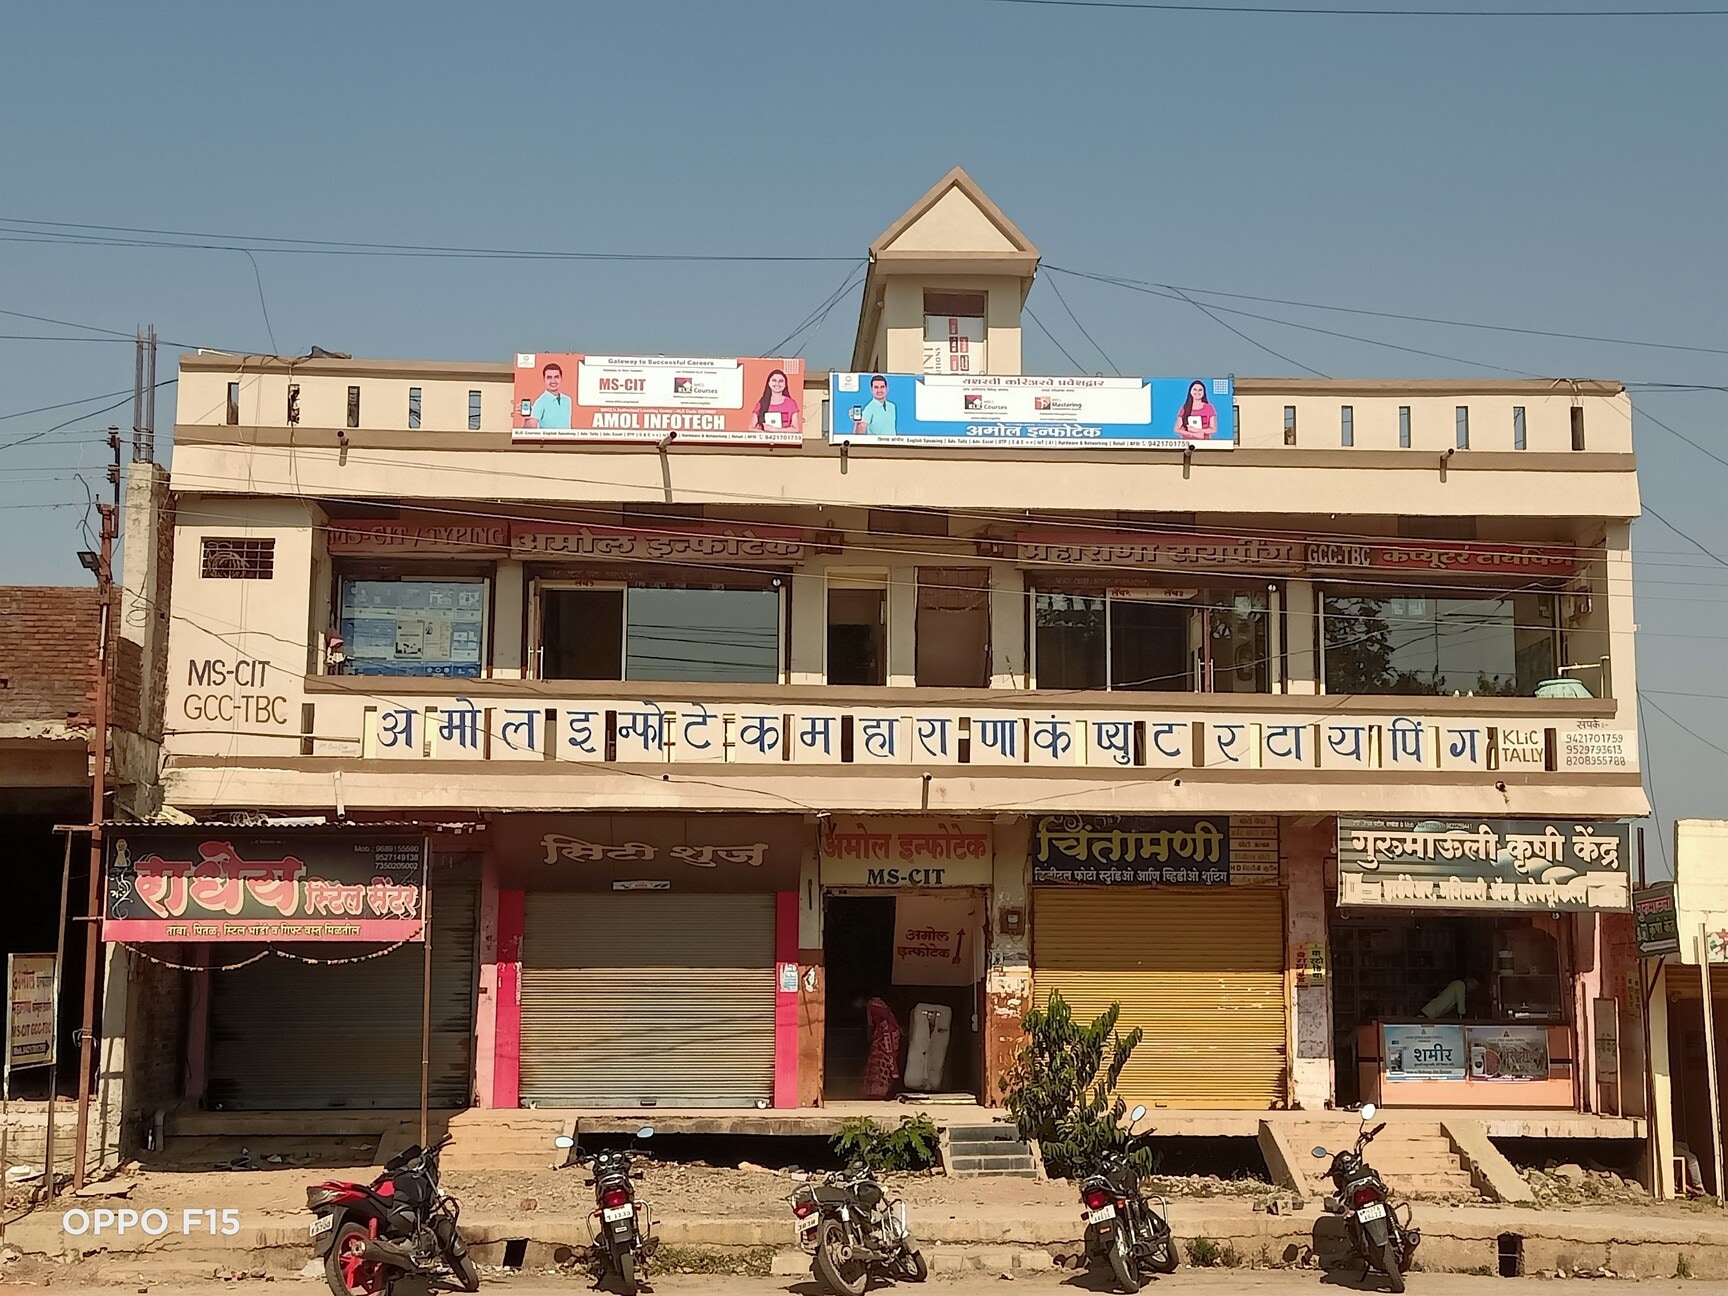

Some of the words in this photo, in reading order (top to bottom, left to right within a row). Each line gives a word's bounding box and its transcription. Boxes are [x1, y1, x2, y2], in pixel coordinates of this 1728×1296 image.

[608, 358, 637, 366] Gateway
[599, 377, 646, 391] MS-CIT
[592, 412, 640, 429] AMOL
[643, 413, 725, 430] INFOTECH
[965, 422, 1022, 437] अमोल
[1026, 423, 1102, 438] इन्फोटेक
[329, 525, 409, 545] MS-CIT
[426, 526, 505, 546] TYPING
[516, 527, 636, 555] अमोल
[647, 528, 801, 558] इन्फोटेक
[1022, 543, 1159, 565] महाराणा
[1306, 544, 1371, 567] GCC-TBC
[187, 660, 271, 688] MS-CIT
[183, 693, 288, 725] GCC-TBC
[1502, 729, 1539, 745] KLiC
[1565, 733, 1624, 744] 9421701759
[1501, 747, 1544, 763] TALLY
[1565, 745, 1623, 755] 9529793613
[1565, 756, 1626, 766] 8208955788
[540, 833, 659, 865] सिटी
[824, 822, 892, 860] अमोल
[897, 822, 988, 864] इन्फोटेक
[1036, 817, 1224, 864] चिंतामणी
[1350, 823, 1500, 871] गुरुमाऊली
[1505, 825, 1566, 876] कृषी
[1571, 825, 1620, 870] केंद्र
[867, 868, 945, 885] MS-CIT
[1074, 866, 1097, 882] फोटो
[1136, 867, 1160, 883] आणि
[303, 875, 366, 916] स्टिल
[223, 922, 246, 936] स्टिल
[271, 925, 280, 936] व
[324, 922, 361, 936] मिळतील
[905, 926, 950, 942] अमोल
[897, 943, 951, 960] इन्फोटेक
[1413, 1043, 1453, 1062] शमीर
